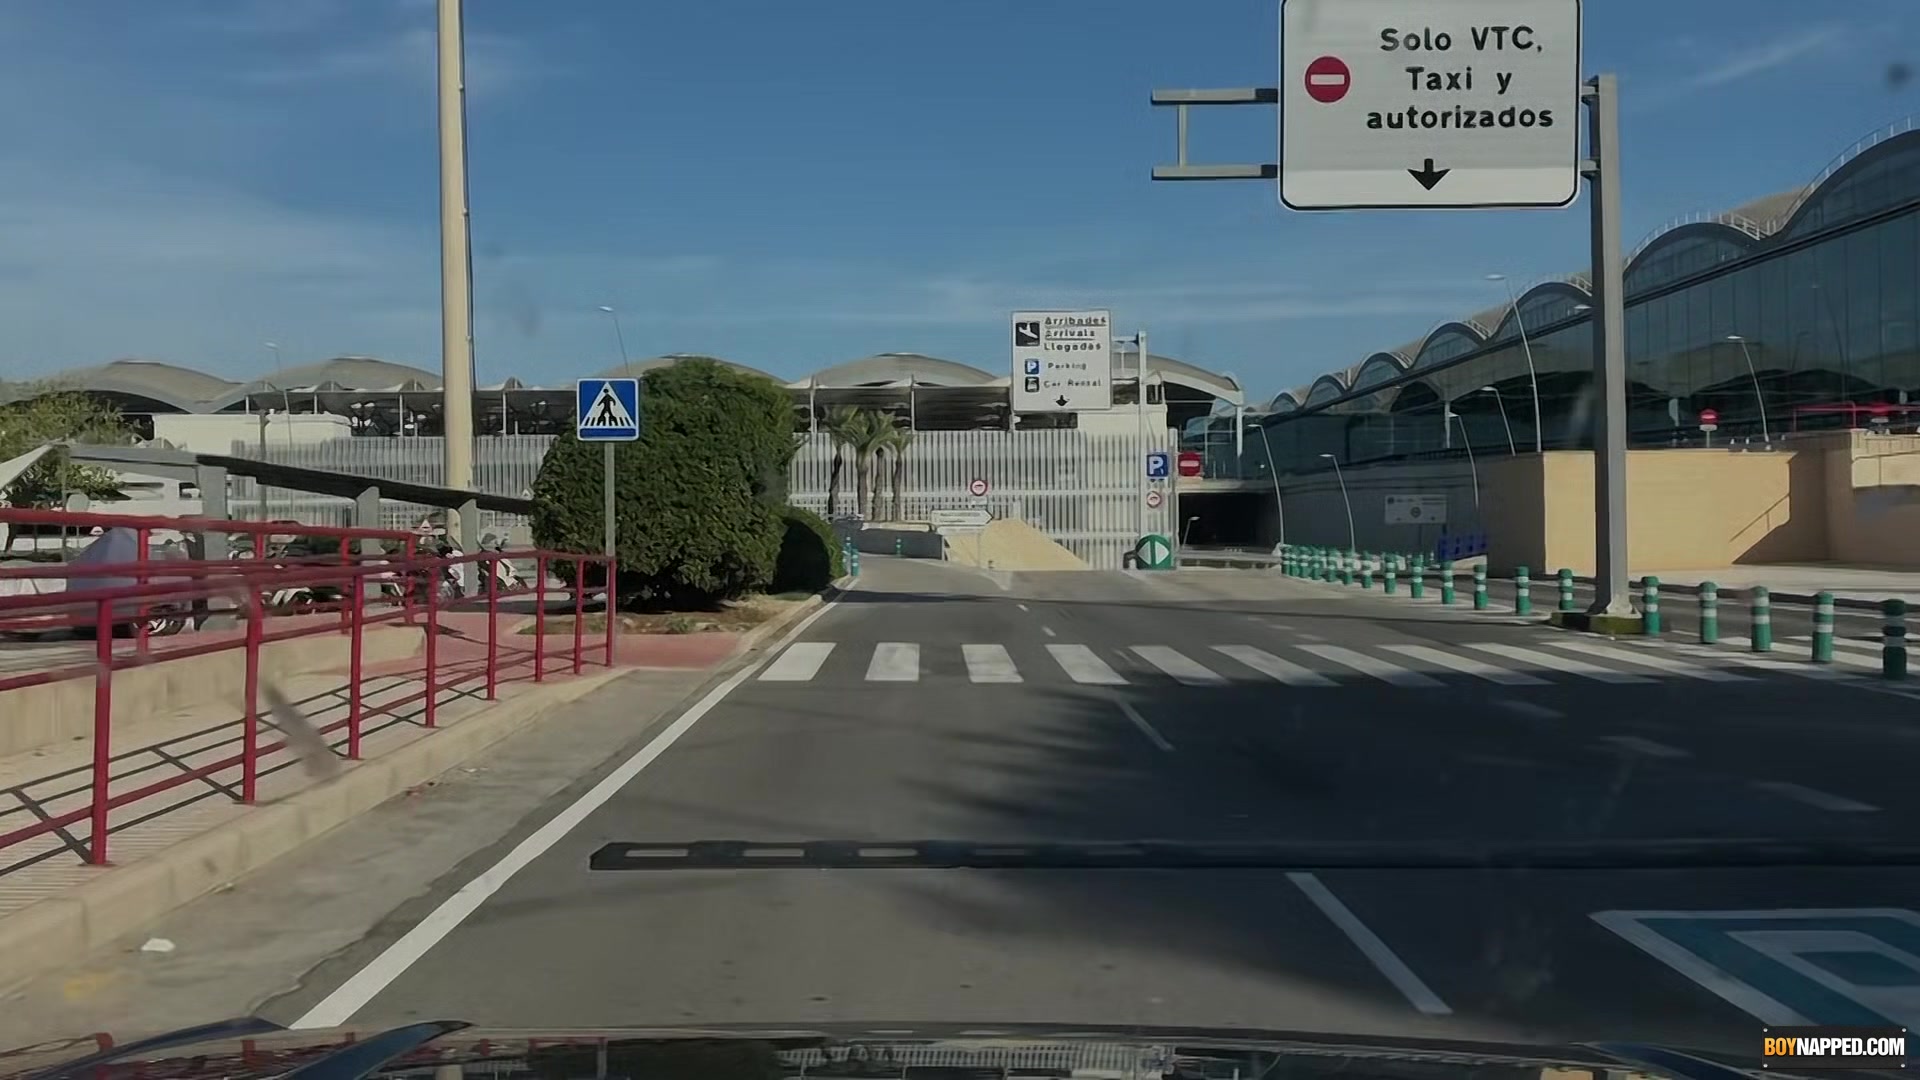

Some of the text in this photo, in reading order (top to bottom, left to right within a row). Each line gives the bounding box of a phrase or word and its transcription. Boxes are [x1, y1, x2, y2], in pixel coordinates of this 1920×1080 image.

[1380, 25, 1543, 53] Solo VTC,
[1405, 66, 1513, 95] Taxi y
[1366, 104, 1554, 129] autorizados
